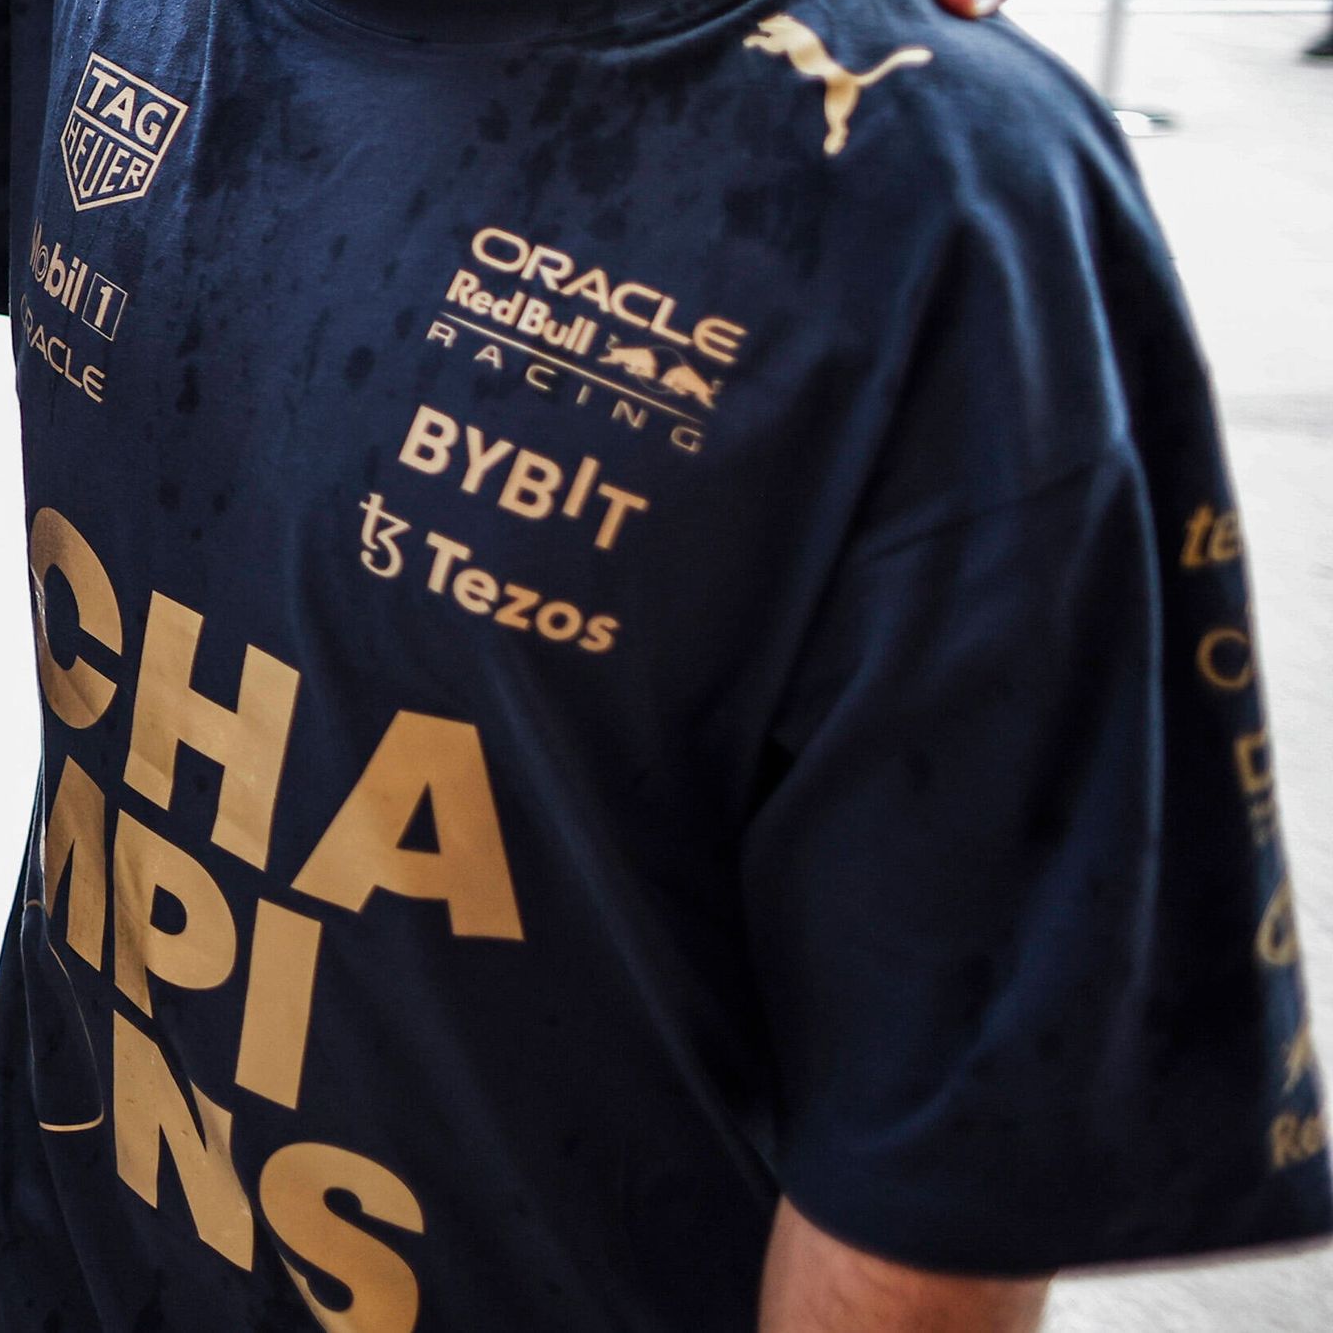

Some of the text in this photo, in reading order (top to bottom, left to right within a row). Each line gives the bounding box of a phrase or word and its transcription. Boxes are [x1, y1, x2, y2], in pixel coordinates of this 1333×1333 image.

[66, 116, 148, 200] HEUER
[85, 67, 167, 146] TAG
[20, 293, 106, 403] ORACLE
[93, 284, 114, 330] 1
[470, 226, 748, 364] ORACLE
[425, 319, 705, 455] RACING
[397, 403, 651, 551] BYBIT
[424, 530, 621, 654] Tezos
[29, 506, 526, 943] CHA
